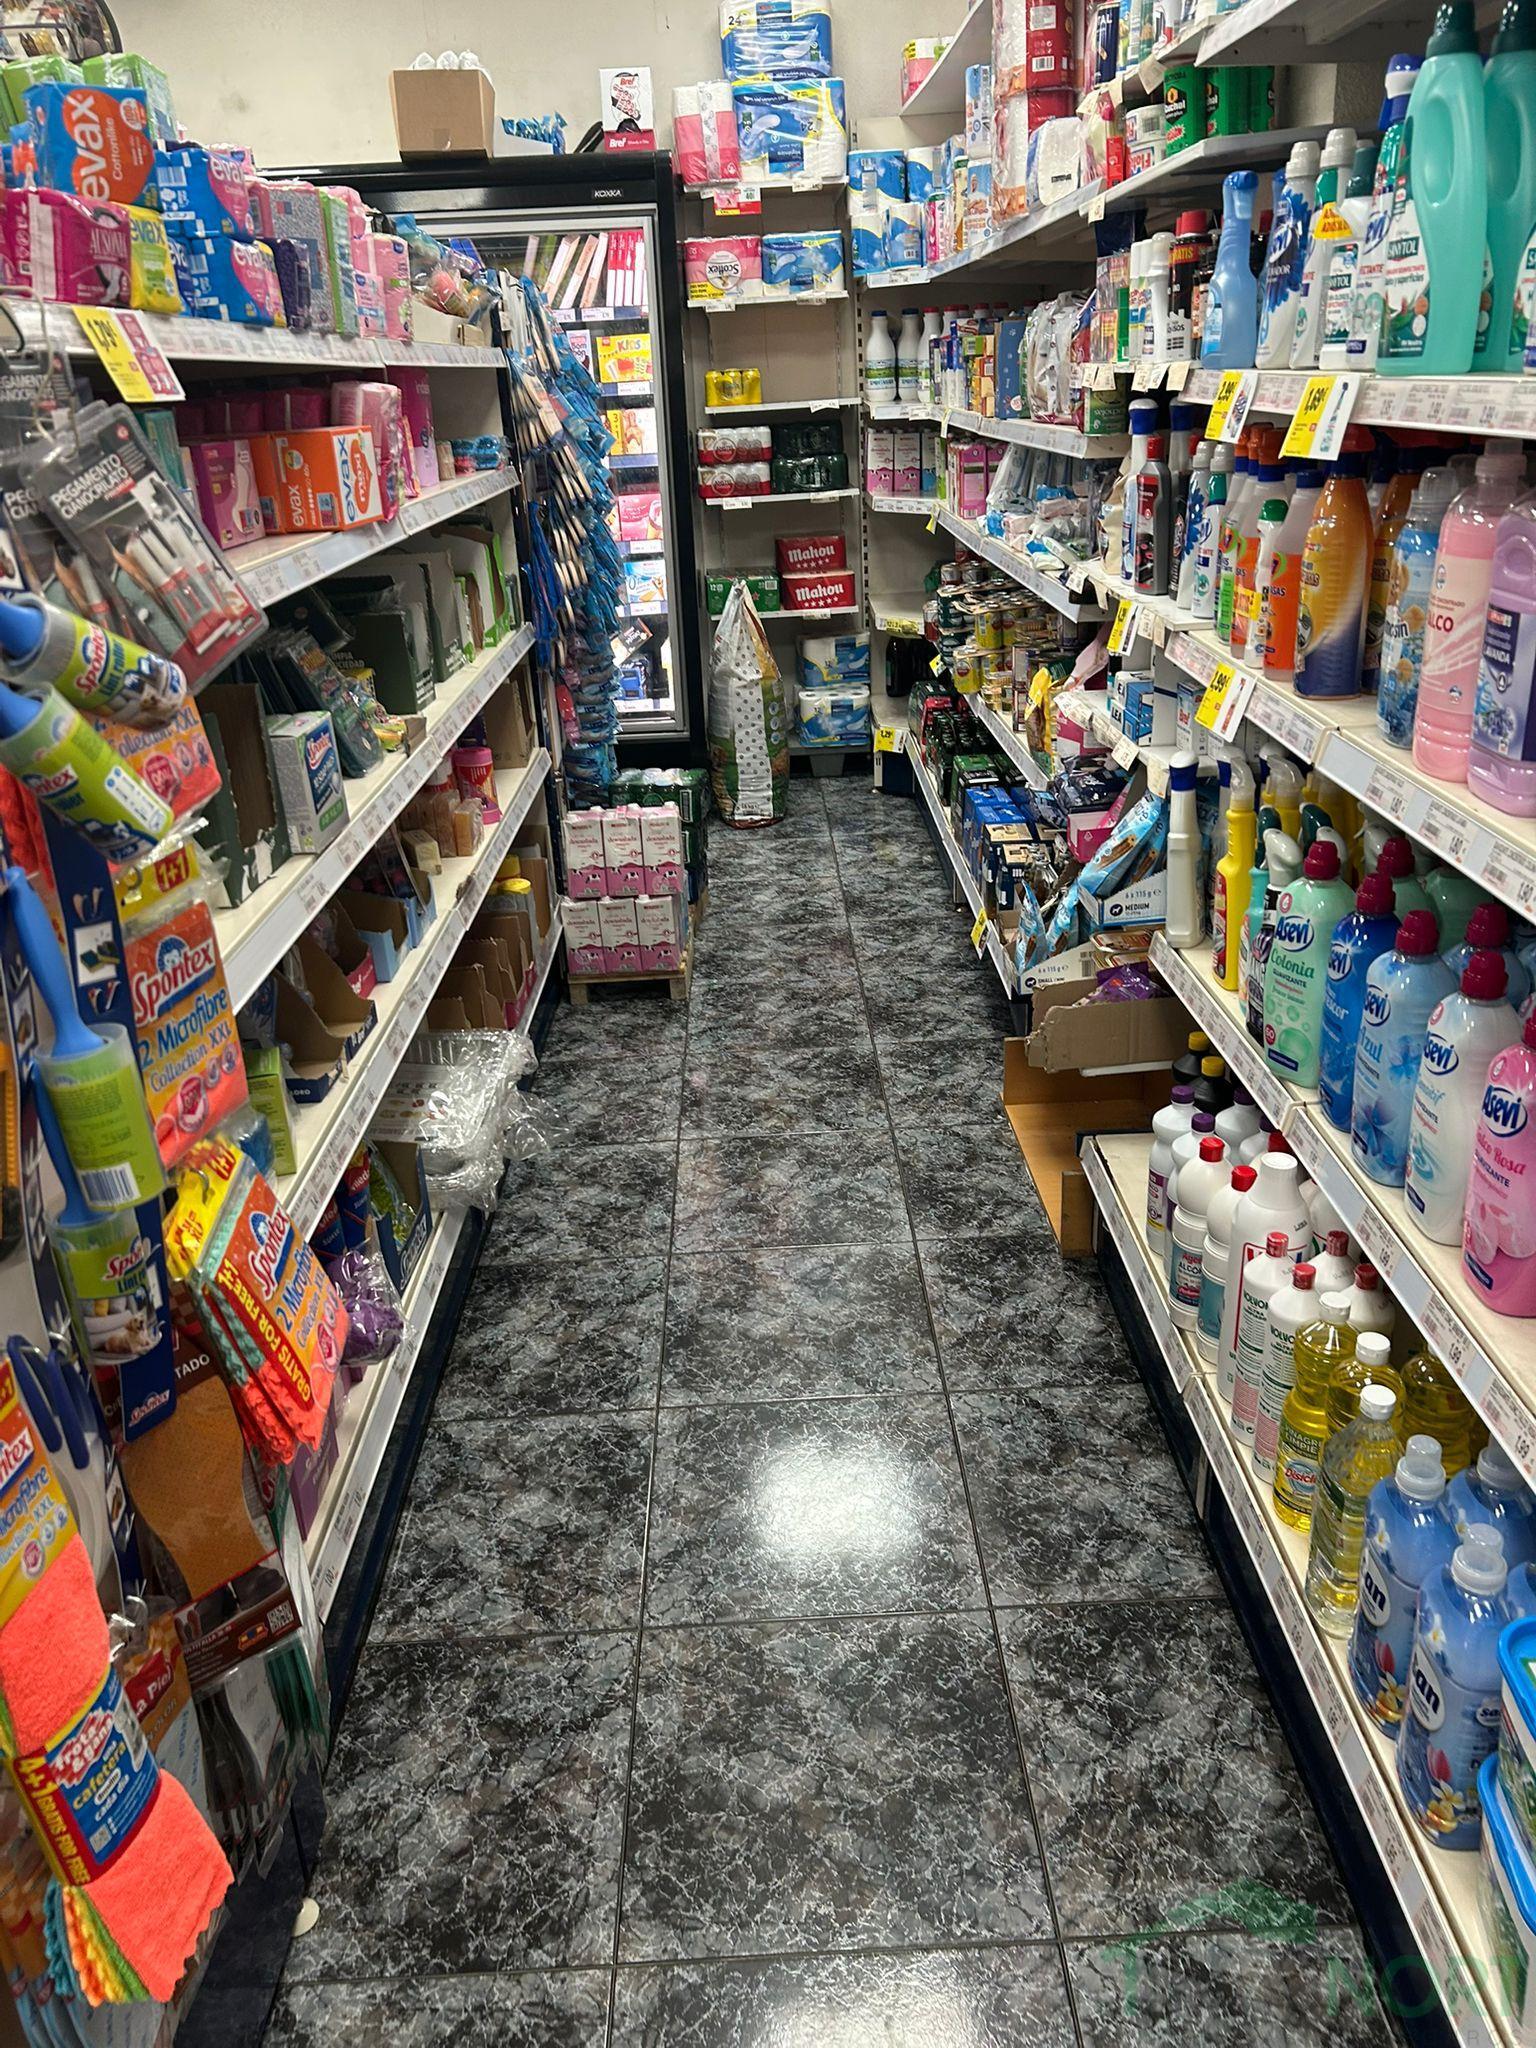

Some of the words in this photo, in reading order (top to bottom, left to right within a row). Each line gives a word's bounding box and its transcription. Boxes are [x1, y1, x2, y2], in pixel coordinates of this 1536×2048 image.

[69, 94, 110, 201] evax
[109, 117, 123, 181] Cottonlike
[609, 137, 627, 148] Bref
[210, 157, 245, 184] eva
[594, 189, 622, 198] KOXKA
[131, 221, 163, 244] evax
[50, 453, 121, 507] PEGAMENTO
[60, 467, 129, 520] CIANOCRILATO
[338, 437, 355, 522] evax
[289, 485, 304, 526] evax
[788, 545, 835, 562] Mahou
[795, 583, 844, 600] Mahou
[1427, 610, 1454, 633] ALCO
[157, 854, 188, 890] 1+1
[1124, 903, 1150, 911] MEDIUM
[1275, 915, 1312, 944] Asevi
[132, 938, 214, 1027] Spontex
[1271, 949, 1315, 979] Colonia
[139, 1040, 151, 1068] 2
[155, 988, 228, 1060] Microfibre
[150, 1044, 207, 1094] Collection
[208, 1026, 232, 1048] XXL
[1482, 1084, 1522, 1130] Asevi
[248, 1204, 291, 1301] Spontex
[231, 1284, 262, 1323] FREE
[257, 1314, 284, 1354] FOR
[174, 1352, 210, 1381] TADO
[277, 1344, 312, 1403] GRATIS
[0, 1432, 31, 1486] ntex
[1284, 1435, 1319, 1455] LIMPIE
[0, 1465, 50, 1538] icrofibre
[1363, 1570, 1386, 1613] an
[1414, 1668, 1441, 1715] an
[1480, 1706, 1501, 1718] sa
